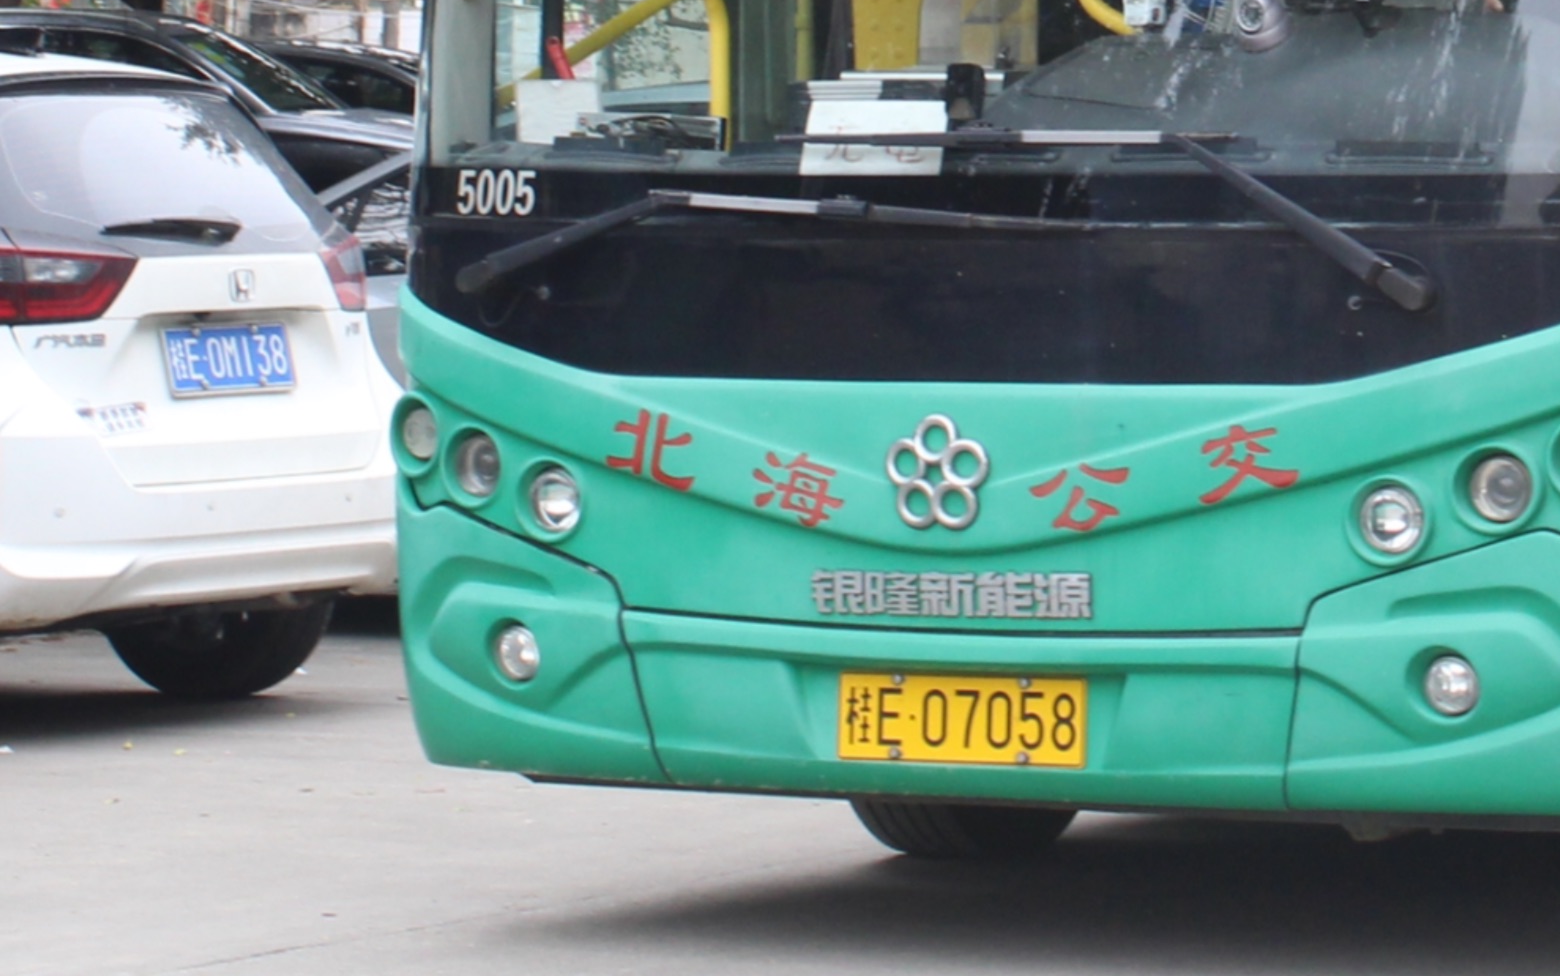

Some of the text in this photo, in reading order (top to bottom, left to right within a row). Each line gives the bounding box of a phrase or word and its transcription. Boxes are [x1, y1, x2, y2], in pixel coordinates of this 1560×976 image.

[457, 170, 536, 215] 5005
[605, 409, 1298, 532] 北海 公交
[811, 570, 1093, 619] 银隆新能源
[846, 687, 1077, 751] 桂E·07058
